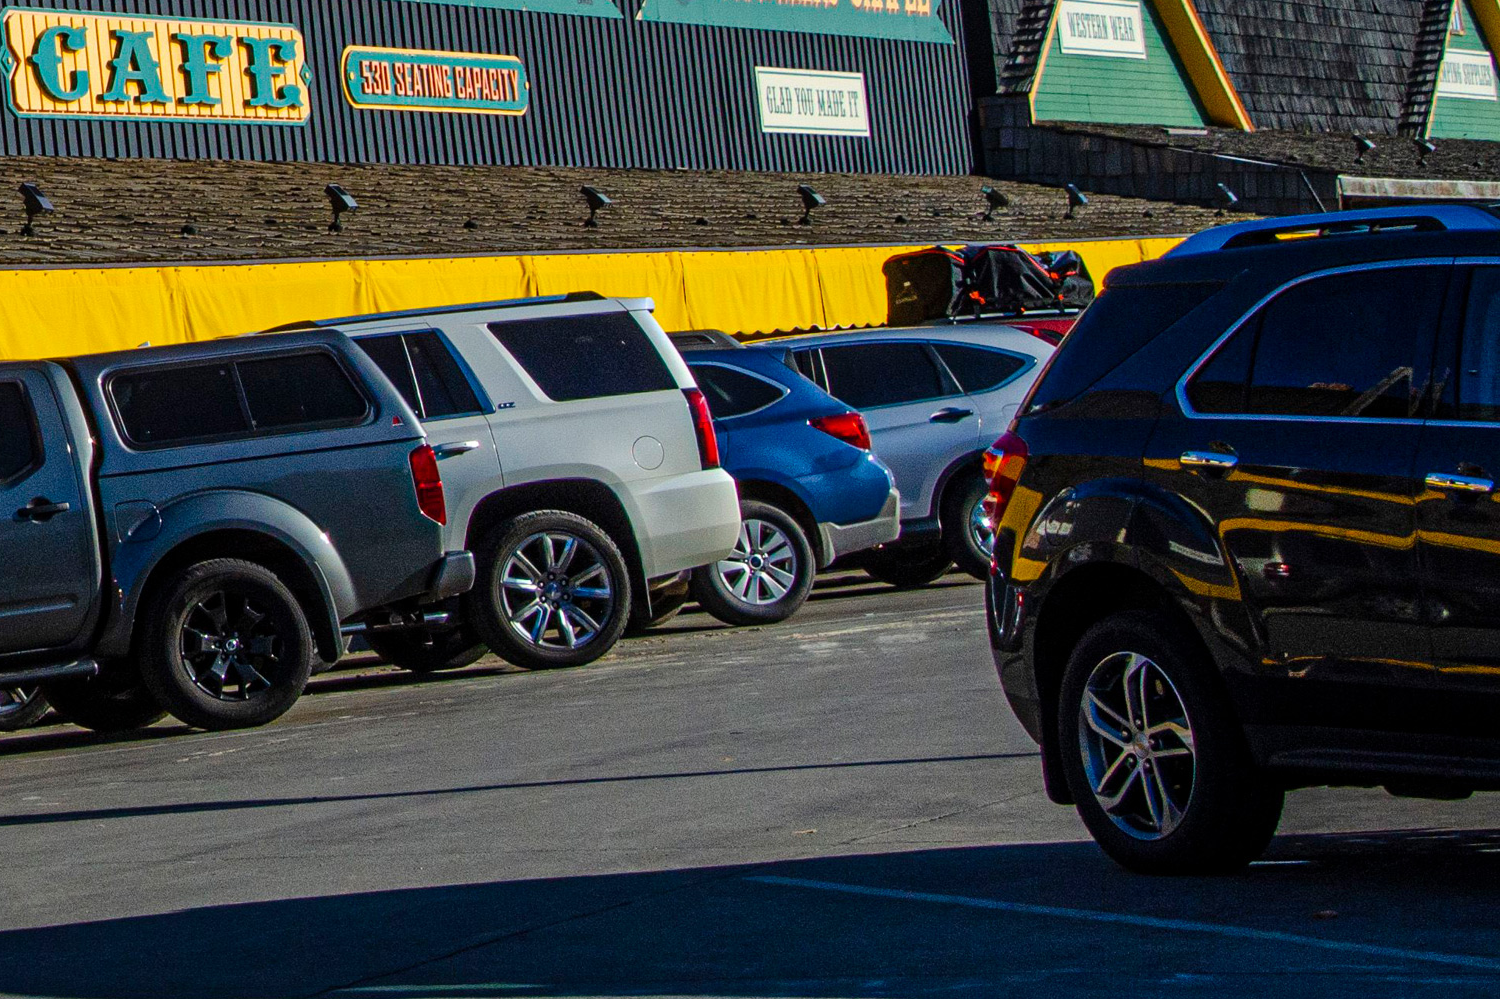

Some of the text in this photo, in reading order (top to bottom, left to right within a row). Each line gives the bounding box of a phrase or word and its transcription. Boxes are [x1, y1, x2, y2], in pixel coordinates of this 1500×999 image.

[1067, 12, 1135, 41] WESTERN WEAR
[27, 25, 304, 109] CAFE
[360, 60, 519, 101] 530 SEATING CAPACITY
[766, 86, 859, 118] GLAD YOU MADE IT
